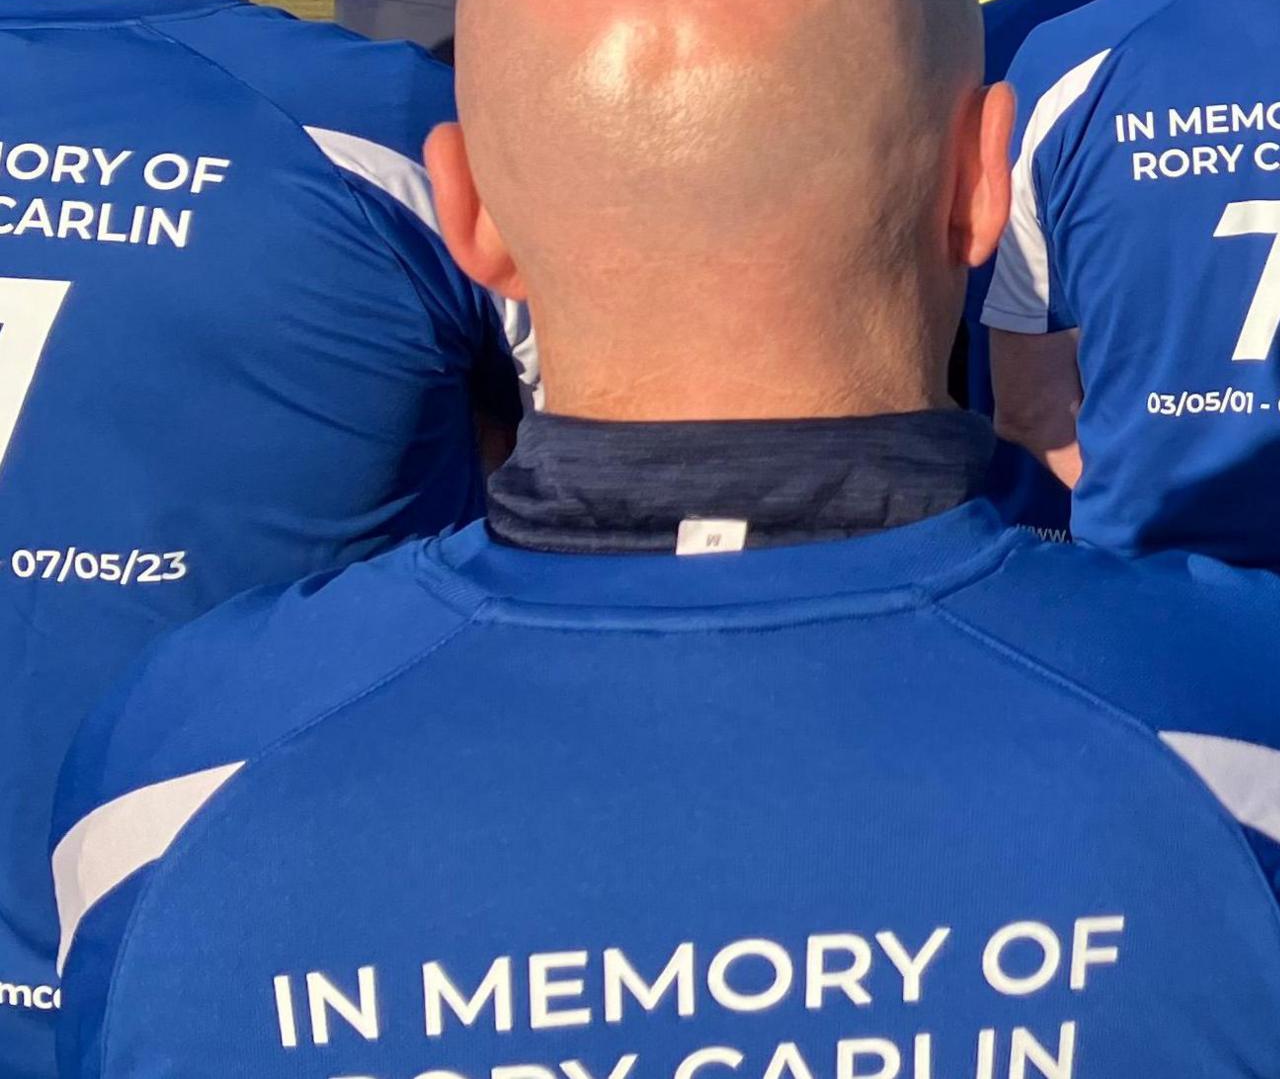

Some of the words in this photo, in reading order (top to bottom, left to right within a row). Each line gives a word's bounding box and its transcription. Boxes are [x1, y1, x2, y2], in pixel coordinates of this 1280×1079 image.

[1115, 111, 1154, 142] IN
[143, 152, 231, 193] OF
[1132, 143, 1244, 180] RORY
[1147, 386, 1254, 417] 03/05/01
[11, 546, 187, 585] 07/05/23
[274, 965, 379, 1047] IN
[422, 927, 951, 1036] MEMORY
[982, 916, 1125, 996] OF
